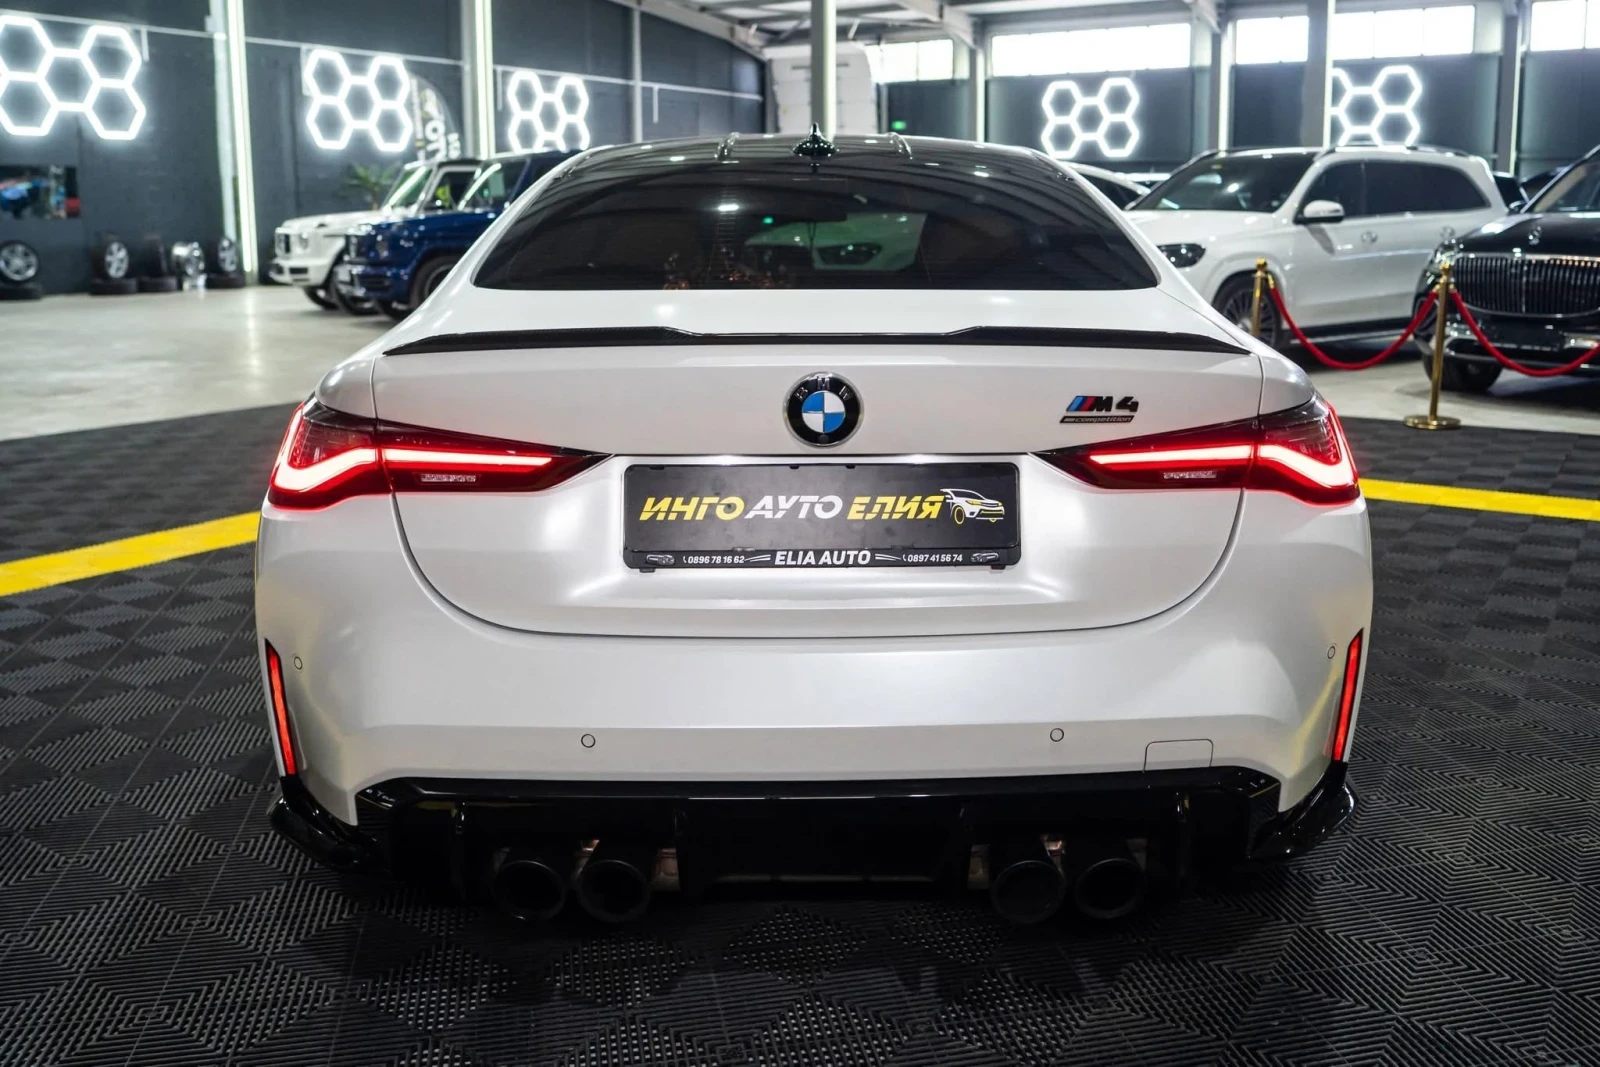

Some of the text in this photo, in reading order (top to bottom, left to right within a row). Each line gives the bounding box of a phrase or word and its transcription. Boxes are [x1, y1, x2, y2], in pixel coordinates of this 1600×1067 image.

[639, 495, 945, 521] ИНГО АУТО ЕЛИЯ
[687, 556, 745, 564] 0896 78 16 62
[774, 550, 871, 565] ELIA AUTO
[907, 554, 929, 562] 0897
[930, 554, 940, 562] 41
[952, 554, 963, 562] 74
